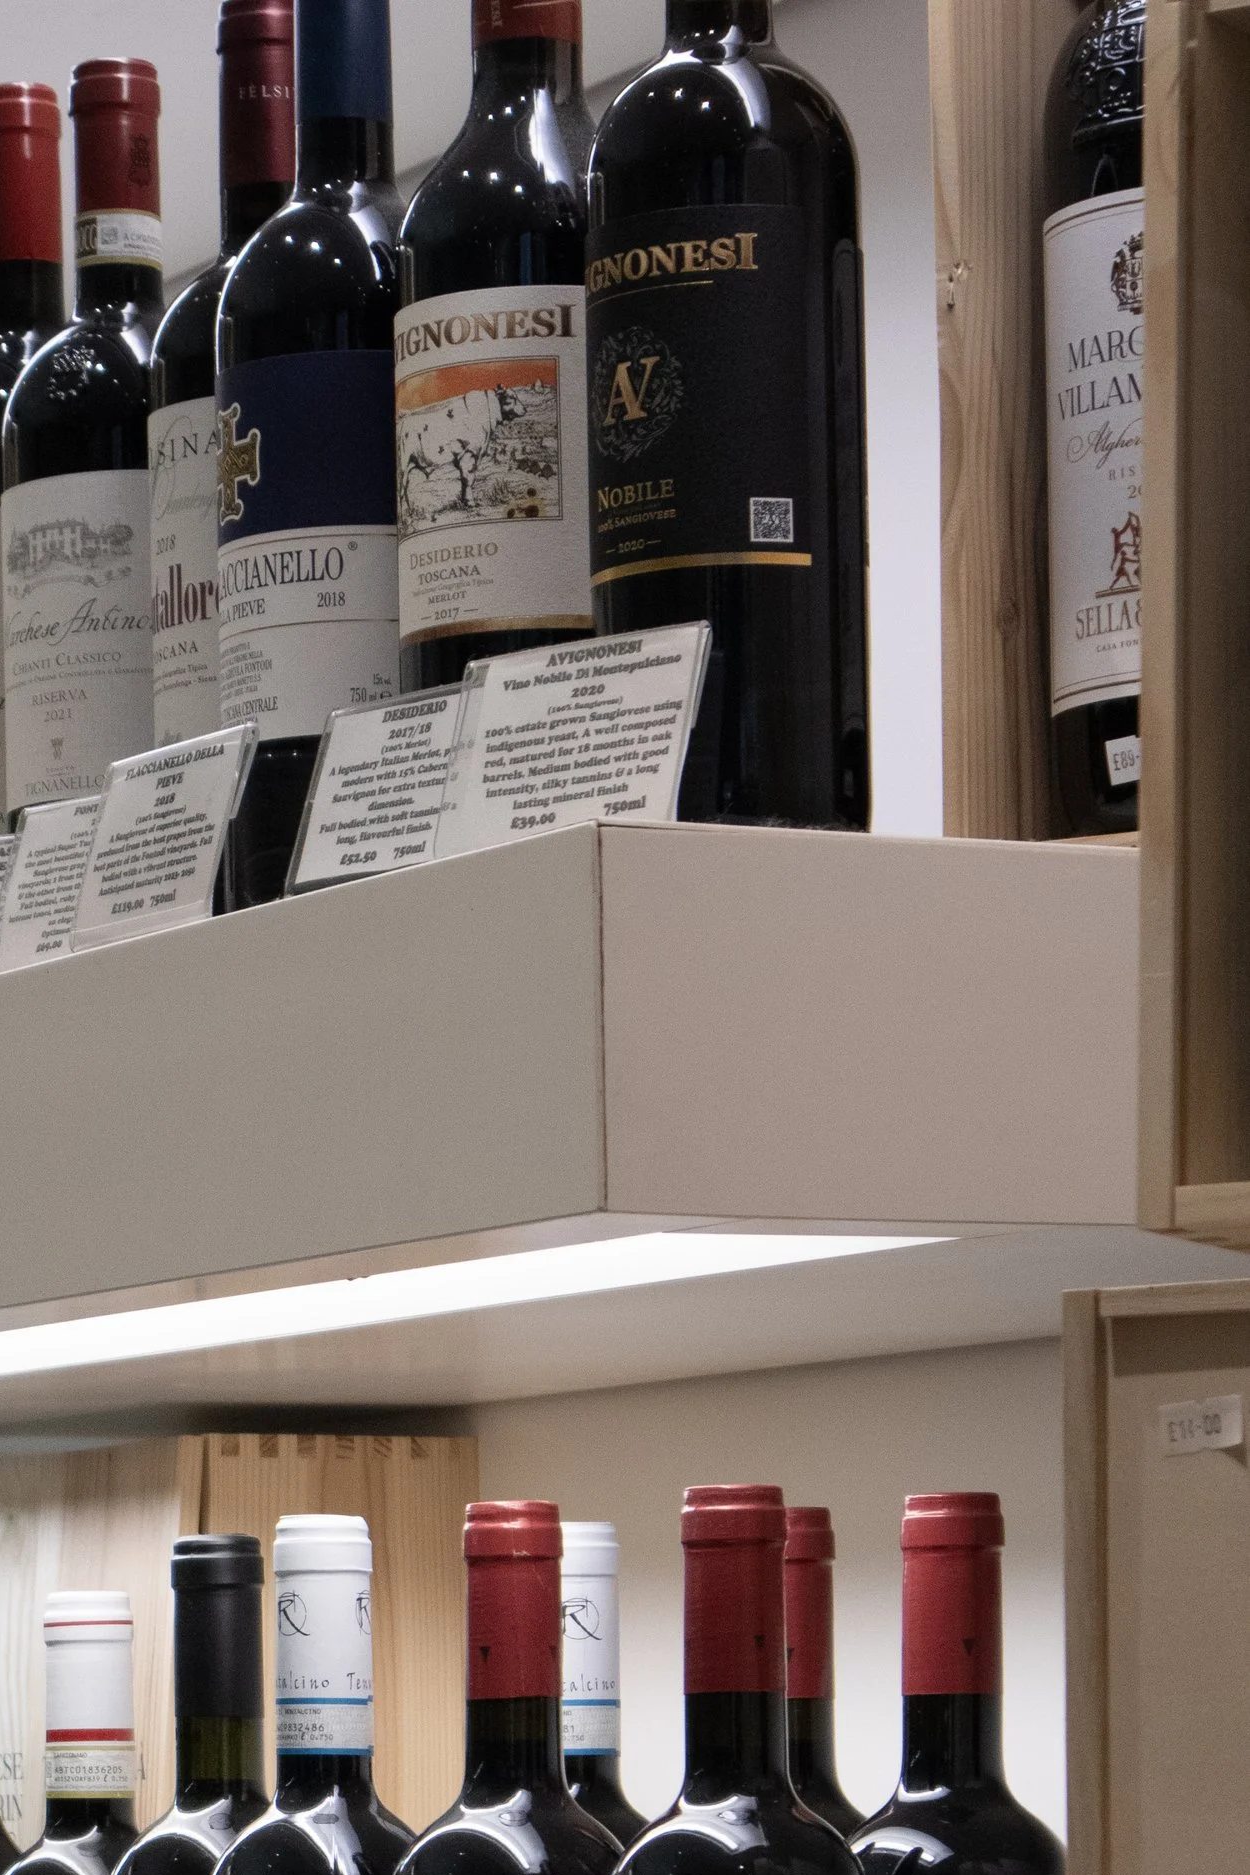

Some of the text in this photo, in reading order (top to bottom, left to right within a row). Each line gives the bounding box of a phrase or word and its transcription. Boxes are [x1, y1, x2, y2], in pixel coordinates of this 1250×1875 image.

[597, 479, 675, 512] NOBILE
[409, 542, 499, 570] DESIDERIO
[418, 564, 481, 586] TOSCANA
[317, 592, 346, 608] 2018
[546, 639, 644, 668] AVIGNONESI
[504, 679, 531, 692] Vino
[533, 671, 573, 687] Nobile
[571, 684, 606, 699] 2020
[382, 700, 448, 724] DESIDERIO
[514, 720, 547, 734] estate
[547, 716, 587, 732] grown
[653, 699, 683, 715] using
[620, 714, 677, 735] composed
[508, 748, 556, 766] matured
[592, 736, 635, 753] months
[510, 796, 647, 831] £39.00 750ml
